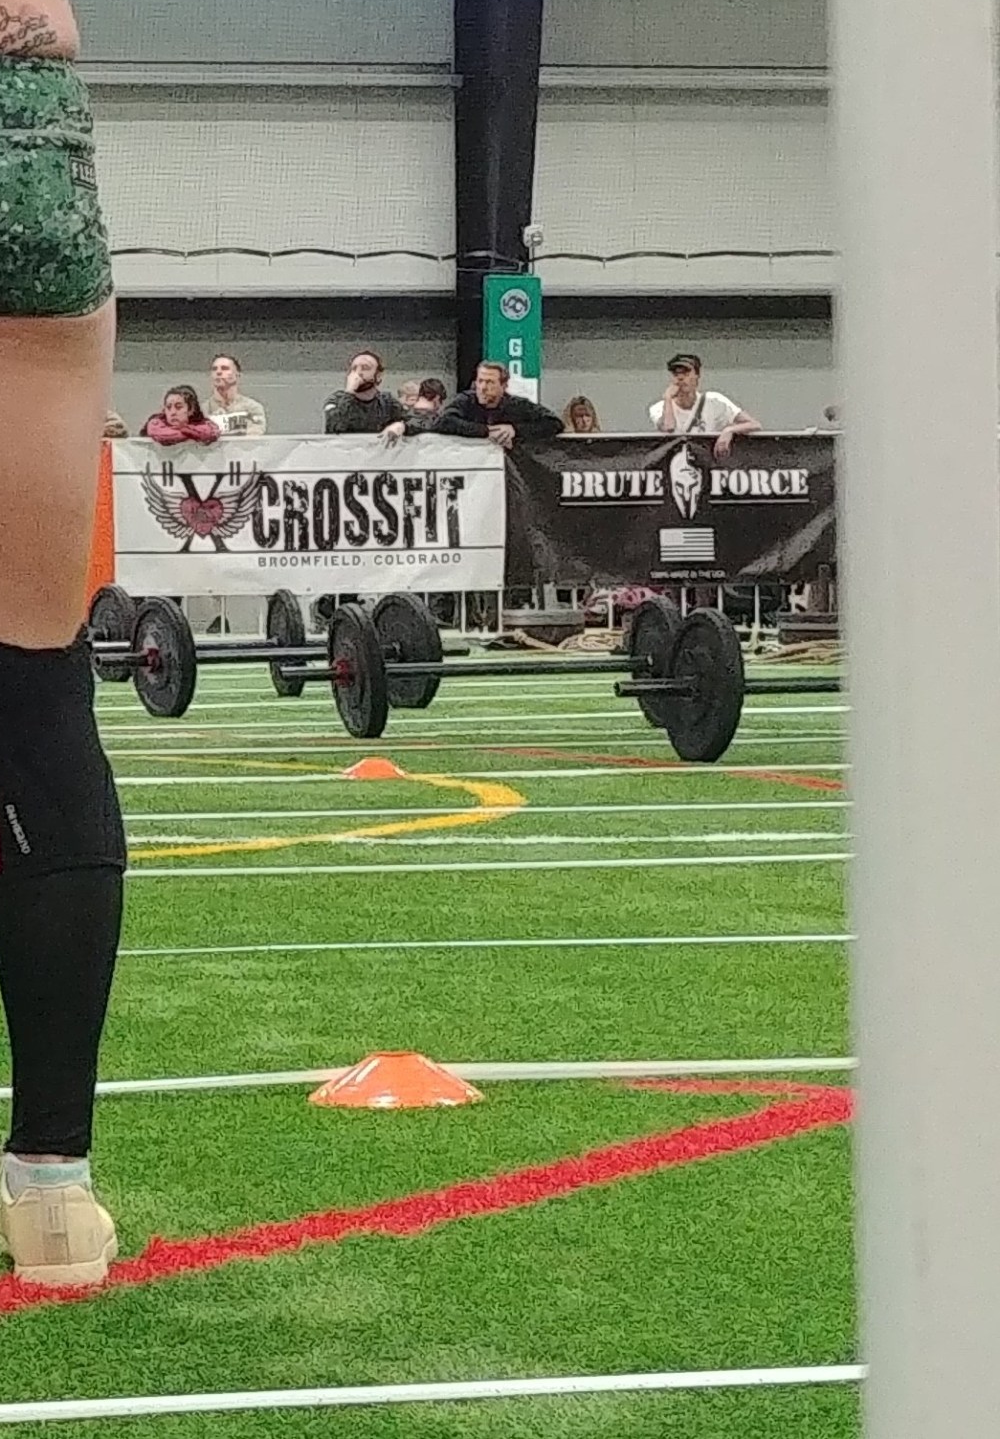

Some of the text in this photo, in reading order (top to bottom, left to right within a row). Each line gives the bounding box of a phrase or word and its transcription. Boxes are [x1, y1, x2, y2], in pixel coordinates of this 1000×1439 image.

[560, 468, 810, 498] BRUTE FORCE
[252, 471, 465, 552] CROSSFIT
[258, 553, 462, 568] BROOMFIELD, COLORADO
